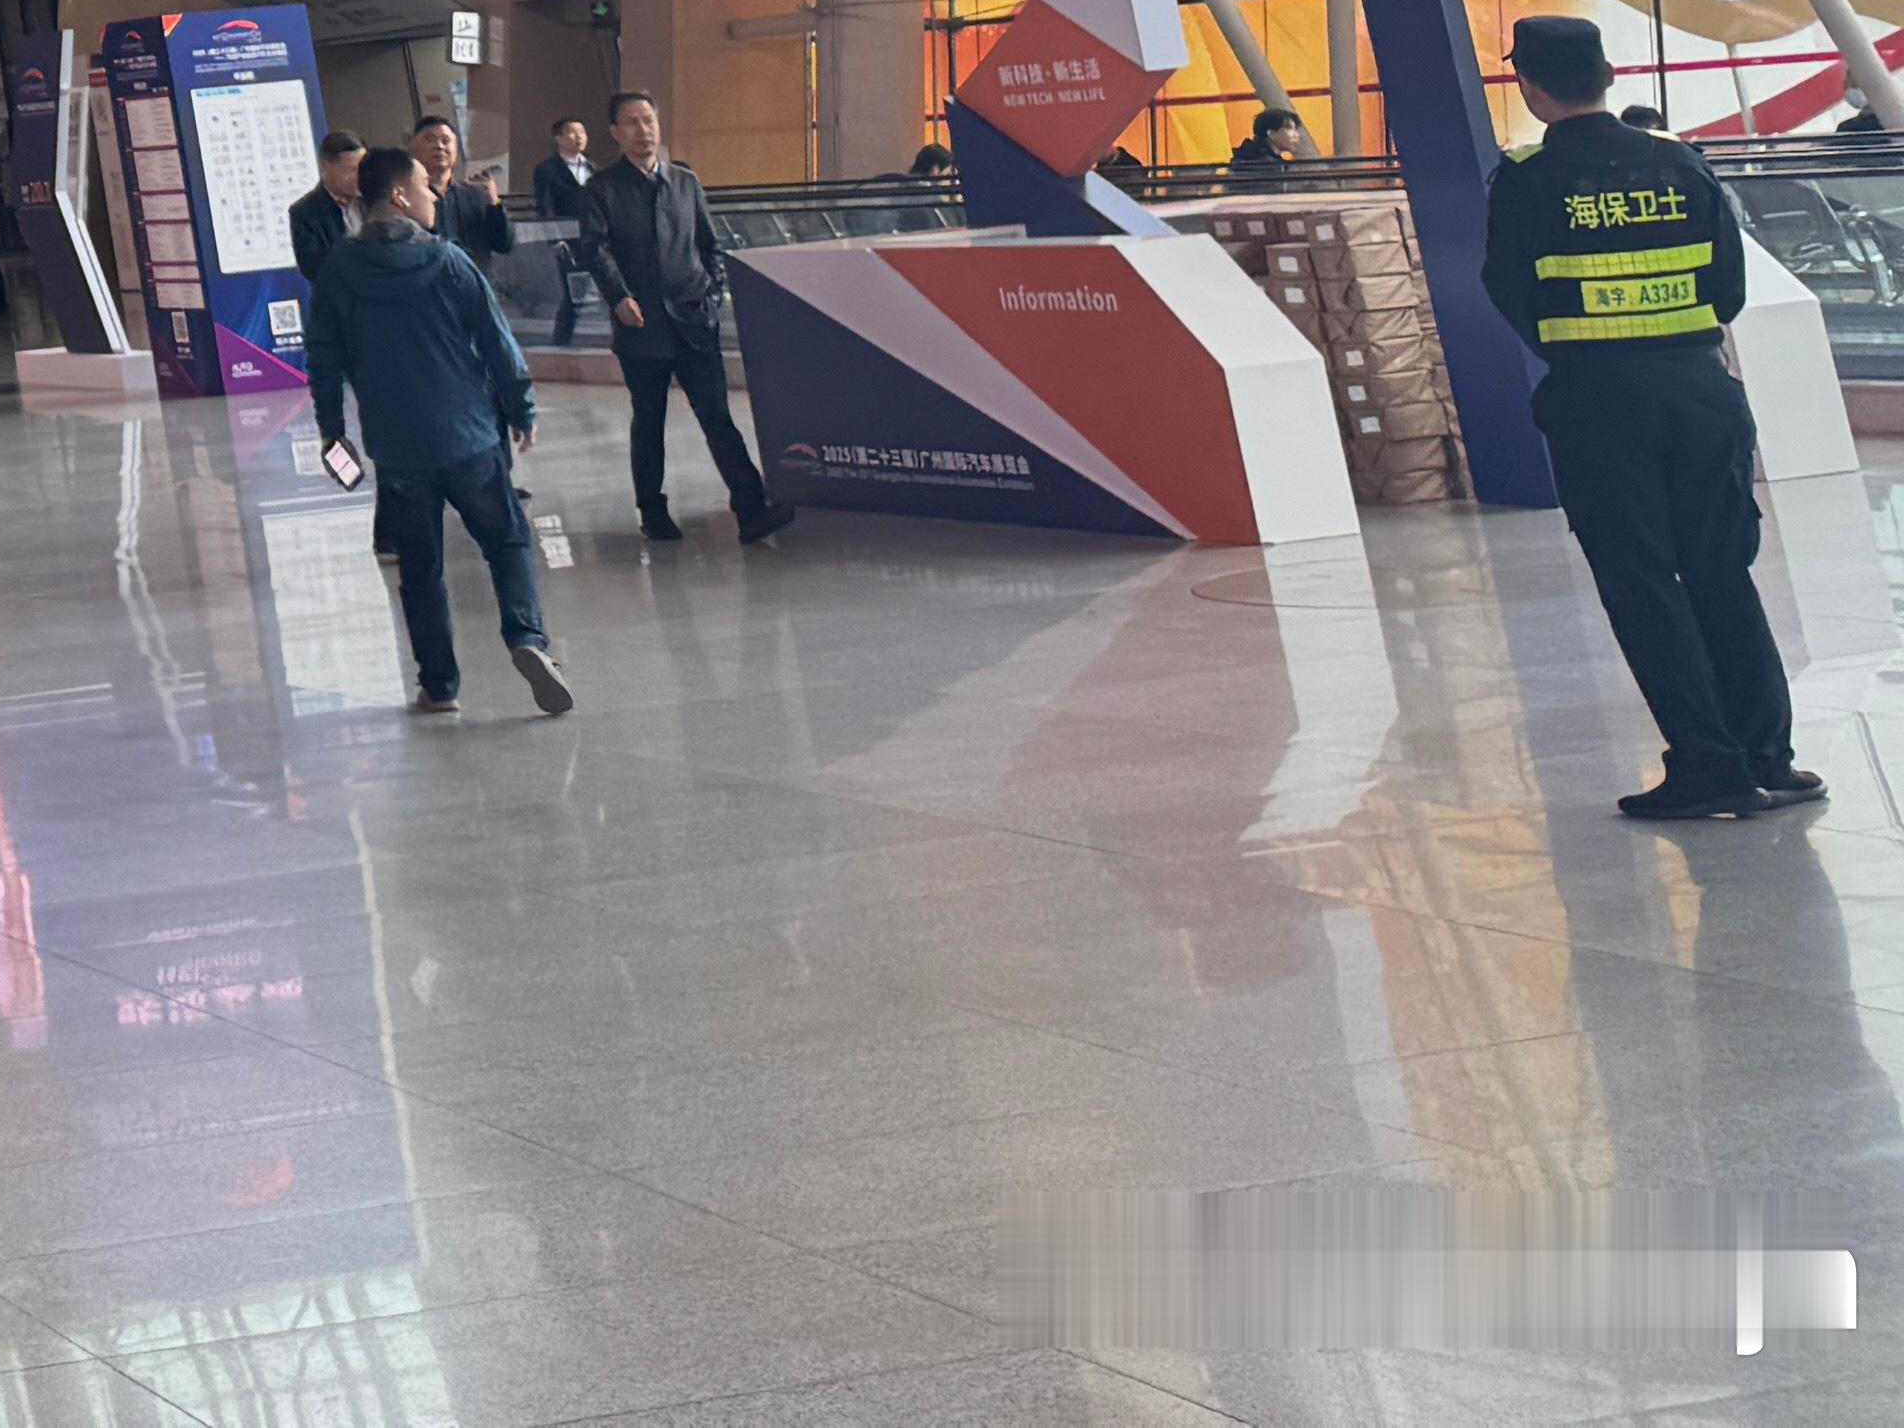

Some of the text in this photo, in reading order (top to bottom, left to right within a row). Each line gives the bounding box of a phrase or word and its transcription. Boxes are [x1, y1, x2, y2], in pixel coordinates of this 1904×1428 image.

[1564, 186, 1688, 230] 海保卫士
[998, 284, 1119, 312] Information
[1639, 281, 1690, 305] A3343
